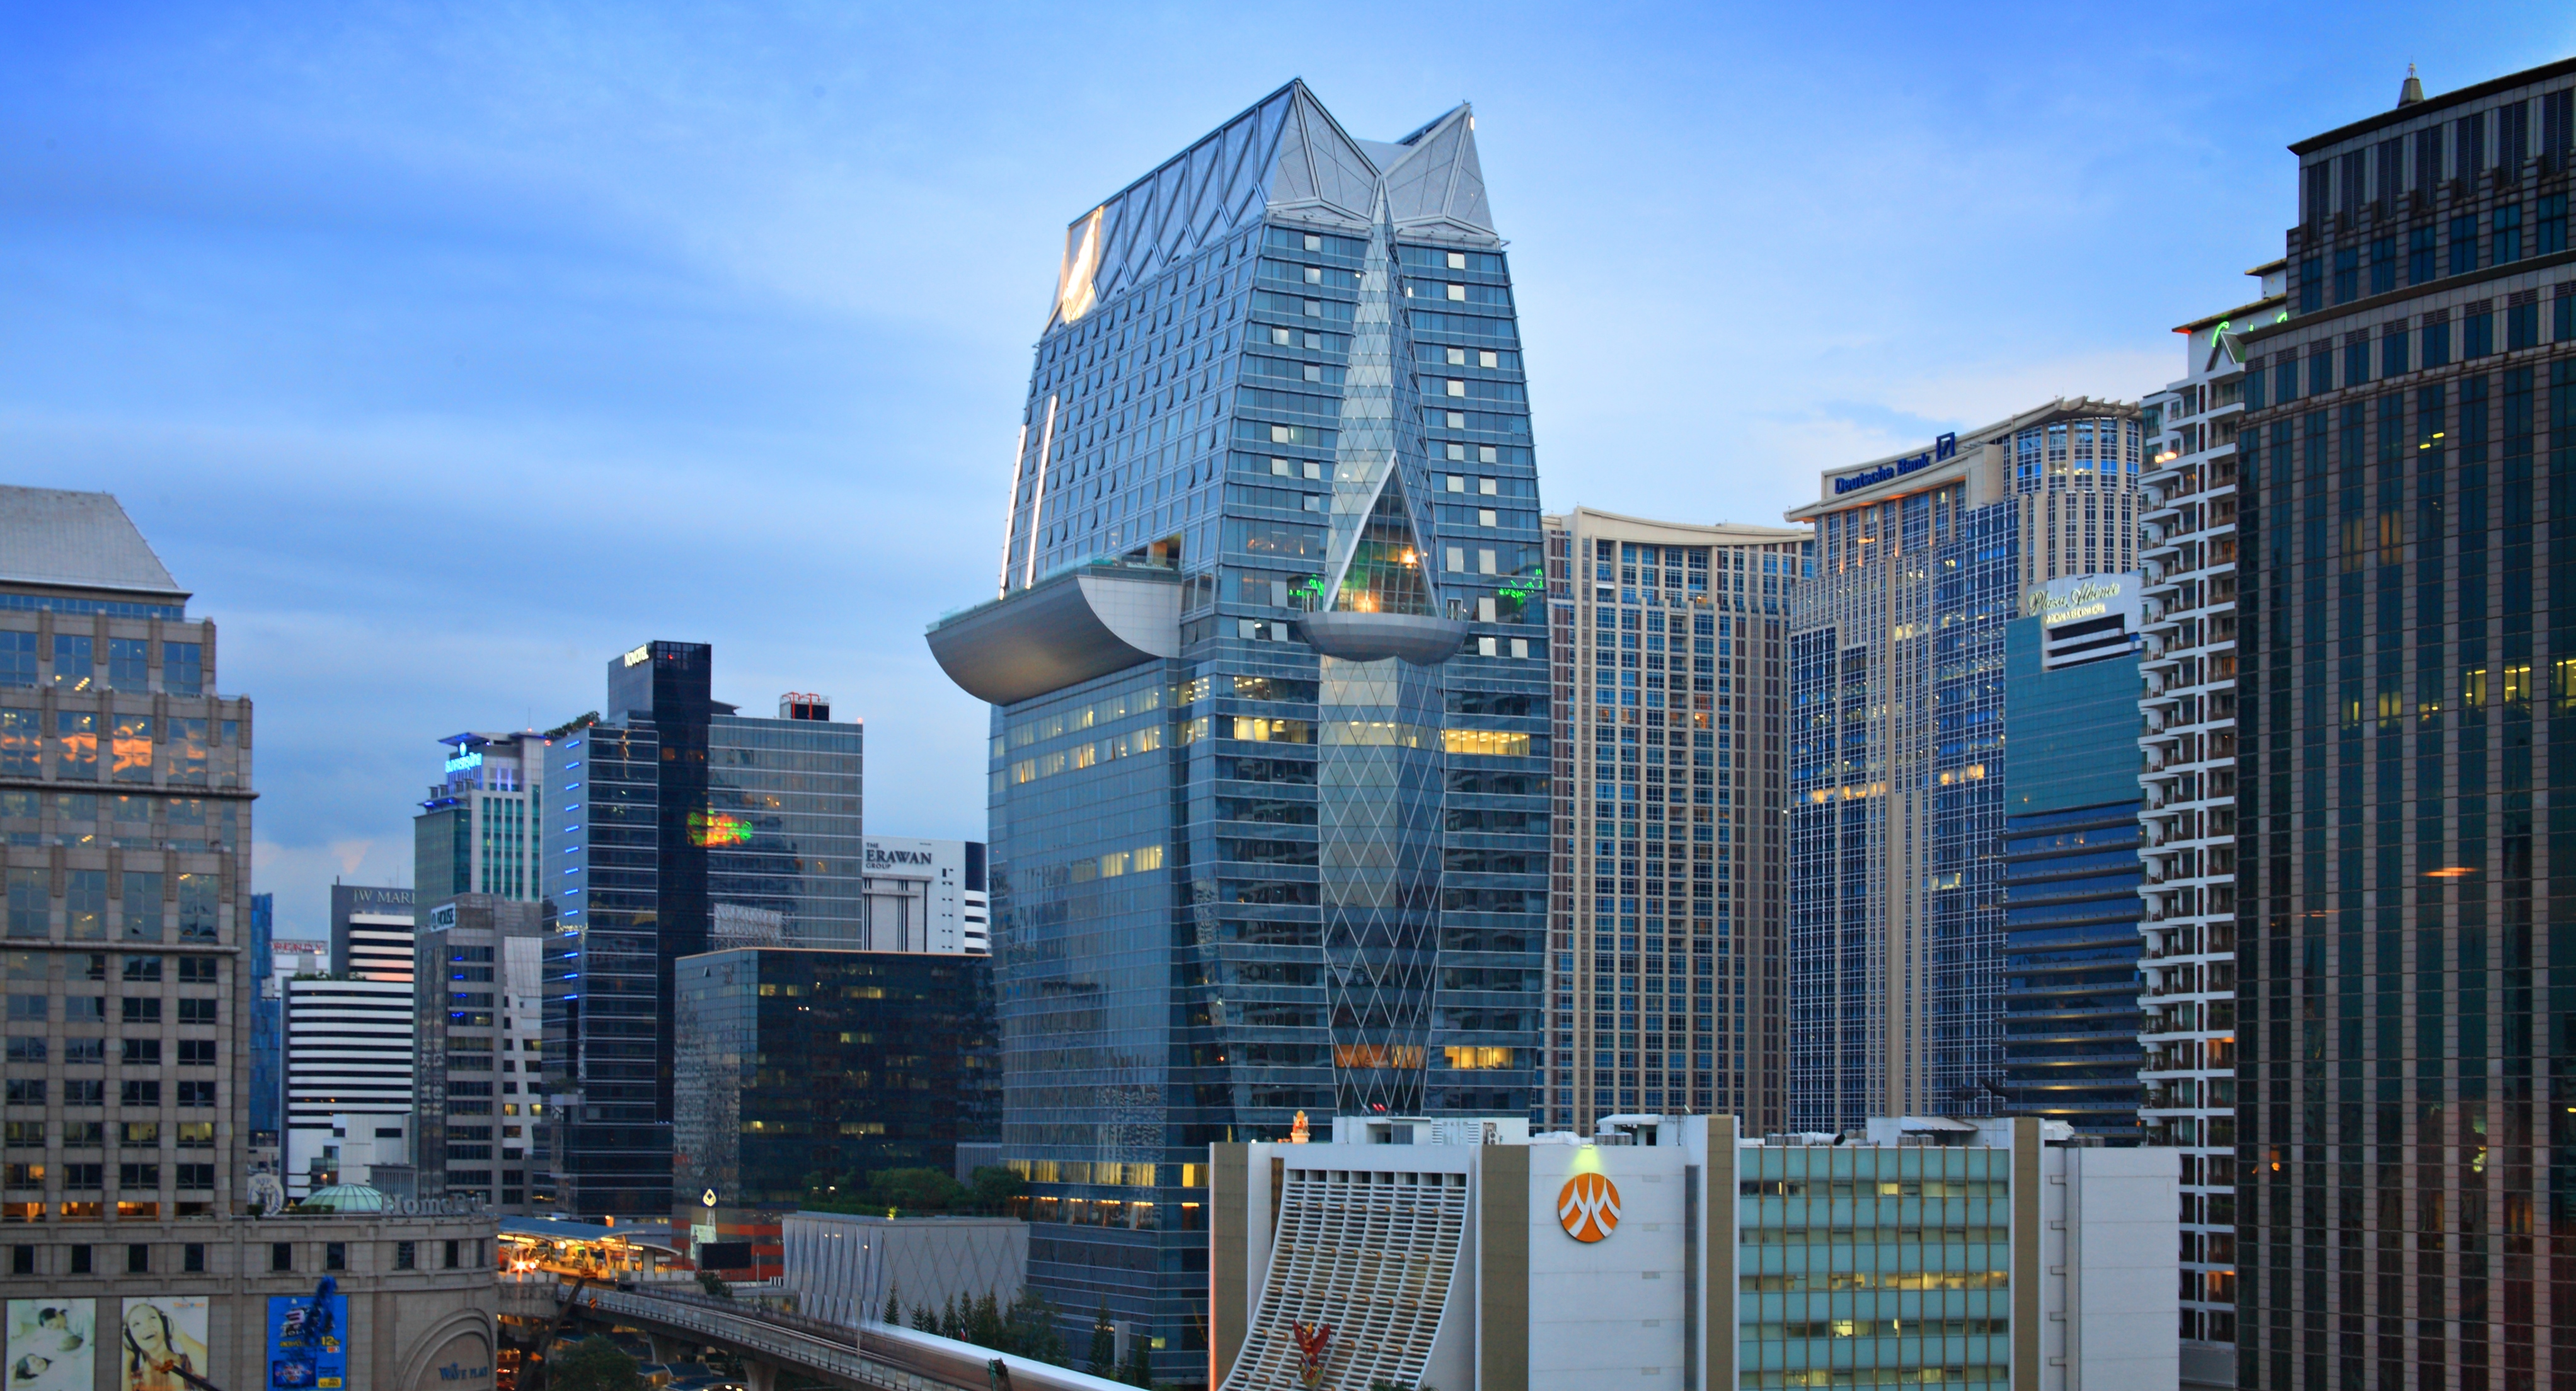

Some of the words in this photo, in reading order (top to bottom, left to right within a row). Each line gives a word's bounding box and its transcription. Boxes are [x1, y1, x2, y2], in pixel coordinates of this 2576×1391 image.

[1834, 465, 1895, 495] Deutsche
[1896, 452, 1931, 476] Bank
[2028, 590, 2066, 617] Plaza
[624, 643, 649, 668] NOVOTEL
[866, 849, 932, 865] ERAWAN
[354, 889, 372, 903] JW
[273, 941, 323, 951] RENDY
